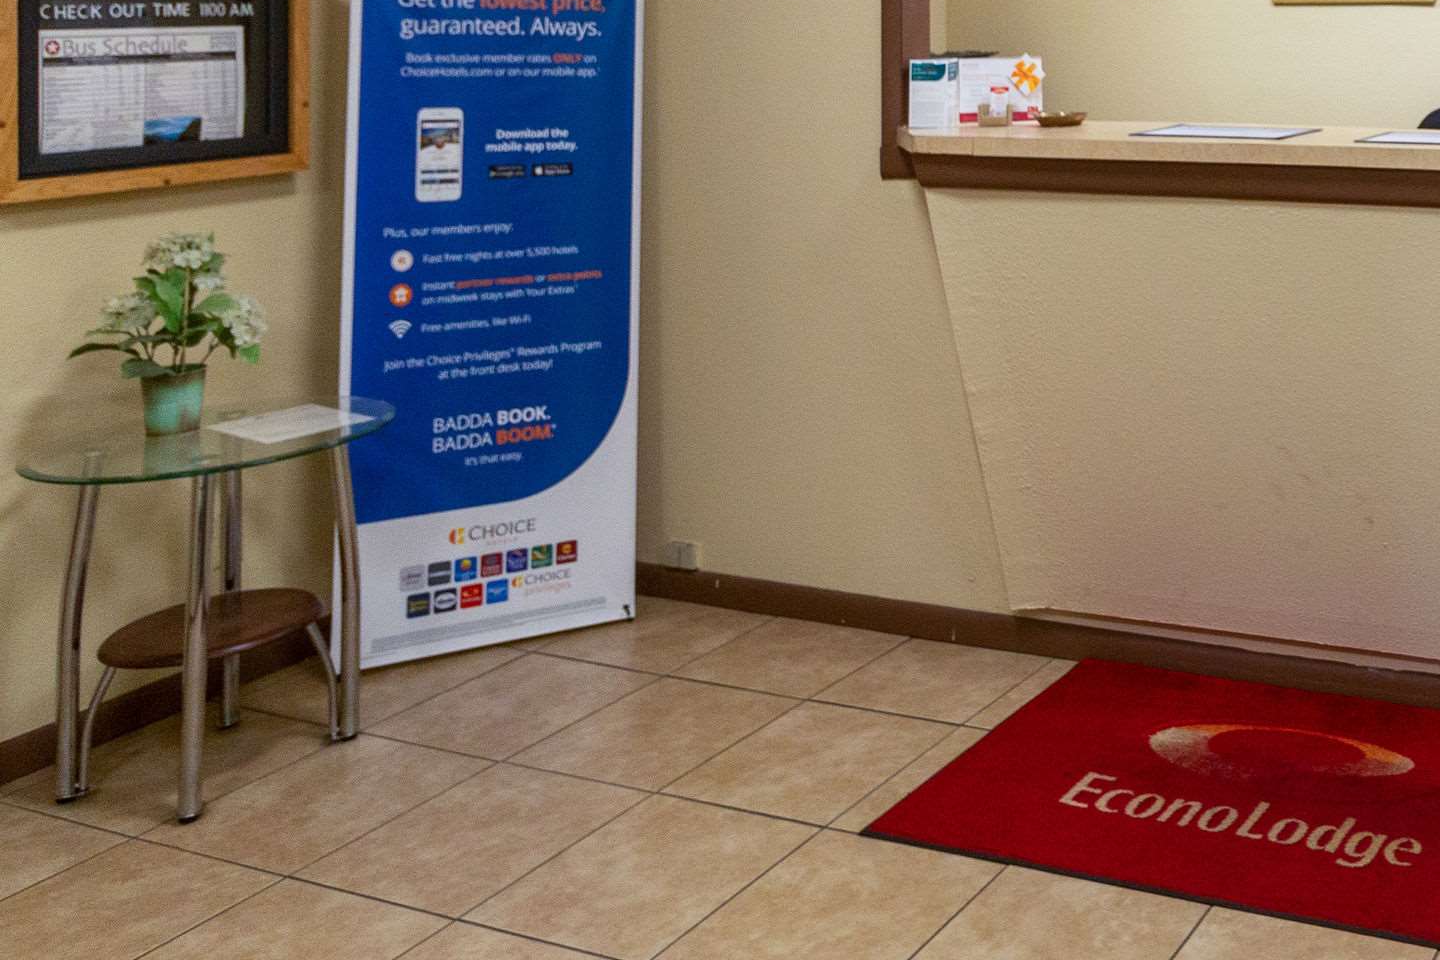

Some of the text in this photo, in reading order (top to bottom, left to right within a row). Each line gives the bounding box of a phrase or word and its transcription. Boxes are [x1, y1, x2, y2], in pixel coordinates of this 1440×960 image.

[39, 3, 103, 20] CHECK
[108, 2, 146, 18] OUT
[152, 2, 191, 17] TIME
[229, 2, 254, 17] AM
[400, 16, 602, 40] guaranteed. Always.
[63, 39, 97, 56] Bus
[101, 35, 188, 56] Schedule
[405, 52, 433, 64] Book
[482, 53, 525, 63] member
[584, 54, 597, 63] on
[494, 69, 505, 77] or
[508, 69, 522, 77] on
[523, 69, 539, 77] our
[541, 66, 575, 77] mobile
[495, 127, 569, 139] Download the
[485, 141, 523, 152] mobile
[524, 142, 545, 153] app
[410, 228, 429, 237] our
[431, 224, 481, 236] members
[383, 360, 405, 373] Join
[406, 357, 425, 368] the
[426, 353, 462, 367] Choice
[516, 346, 559, 357] Rewards
[560, 340, 602, 354] Program
[437, 370, 449, 380] at
[450, 366, 468, 378] the
[469, 364, 495, 377] front
[496, 362, 521, 373] desk
[432, 405, 552, 434] BADDA BOOK.
[431, 432, 494, 454] BADDA
[468, 518, 537, 541] CHOICE
[524, 568, 572, 586] CHOICE
[1058, 770, 1424, 868] EconoLodge
